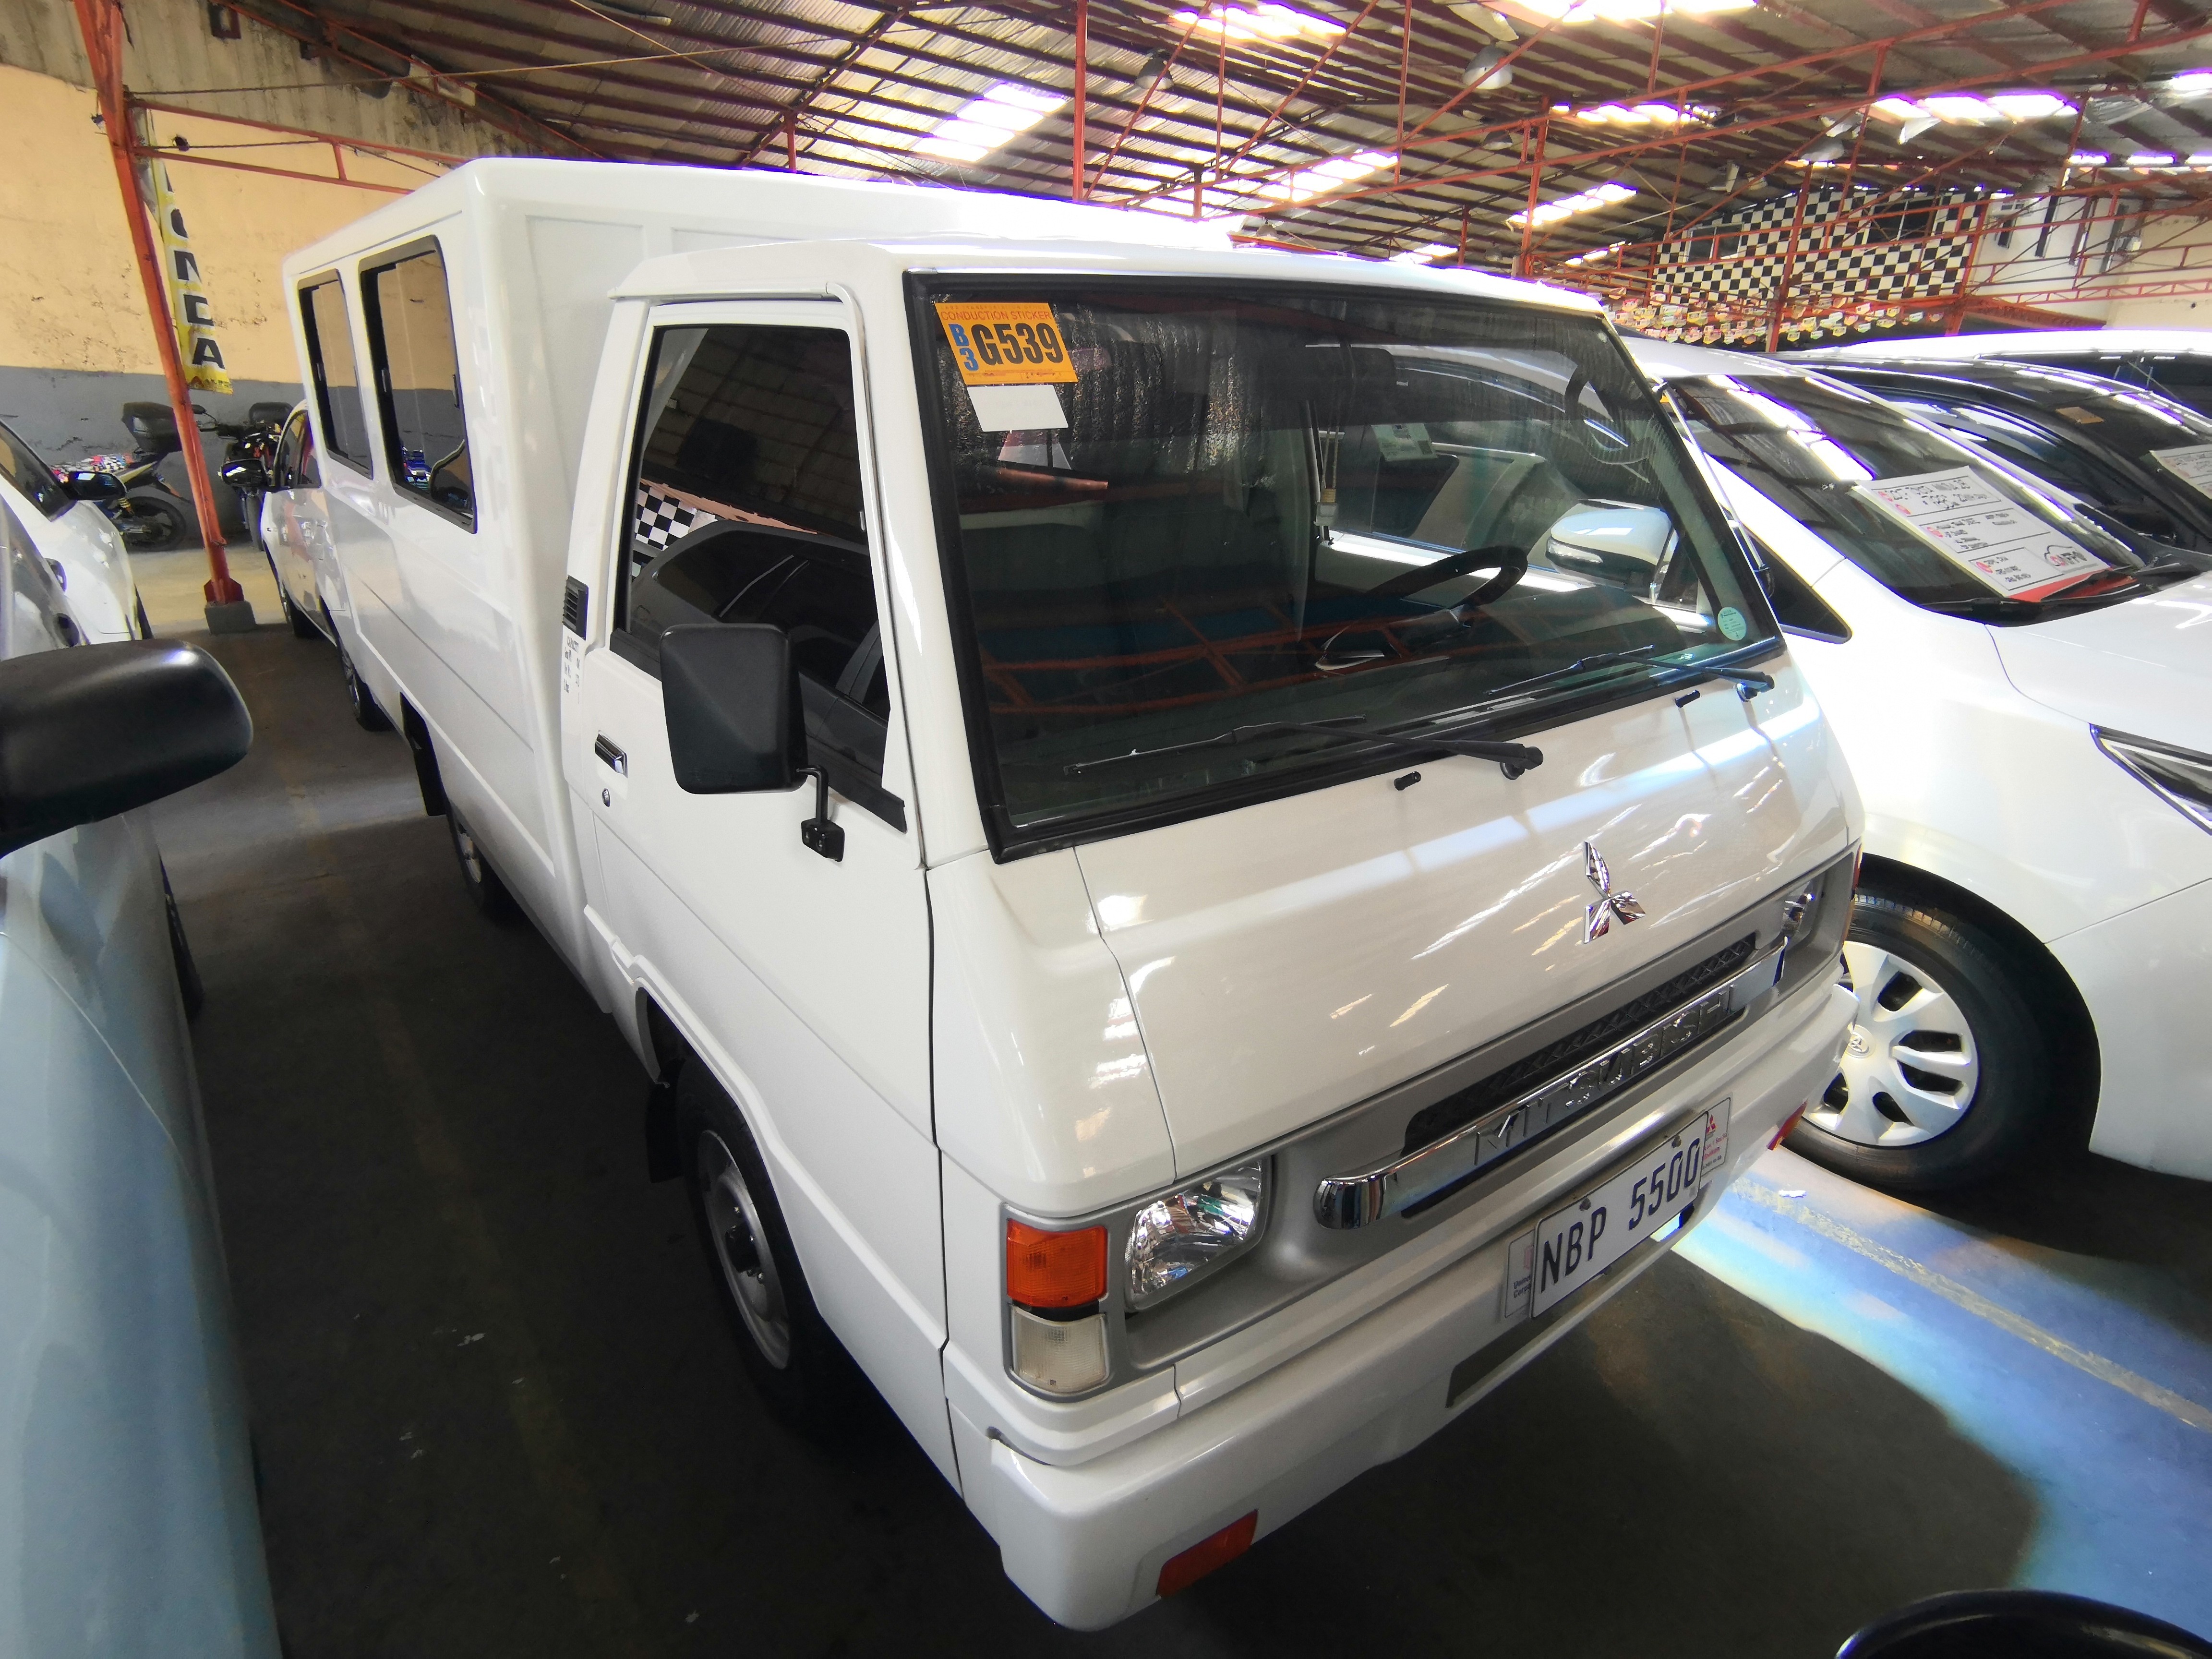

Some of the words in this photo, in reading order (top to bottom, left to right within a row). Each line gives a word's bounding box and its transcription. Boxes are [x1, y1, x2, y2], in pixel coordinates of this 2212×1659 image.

[940, 311, 1009, 321] CONDUCTION
[1010, 311, 1053, 320] STICKER
[971, 322, 1064, 366] G539
[1540, 1205, 1607, 1294] NBP
[1628, 1137, 1701, 1231] 5500
